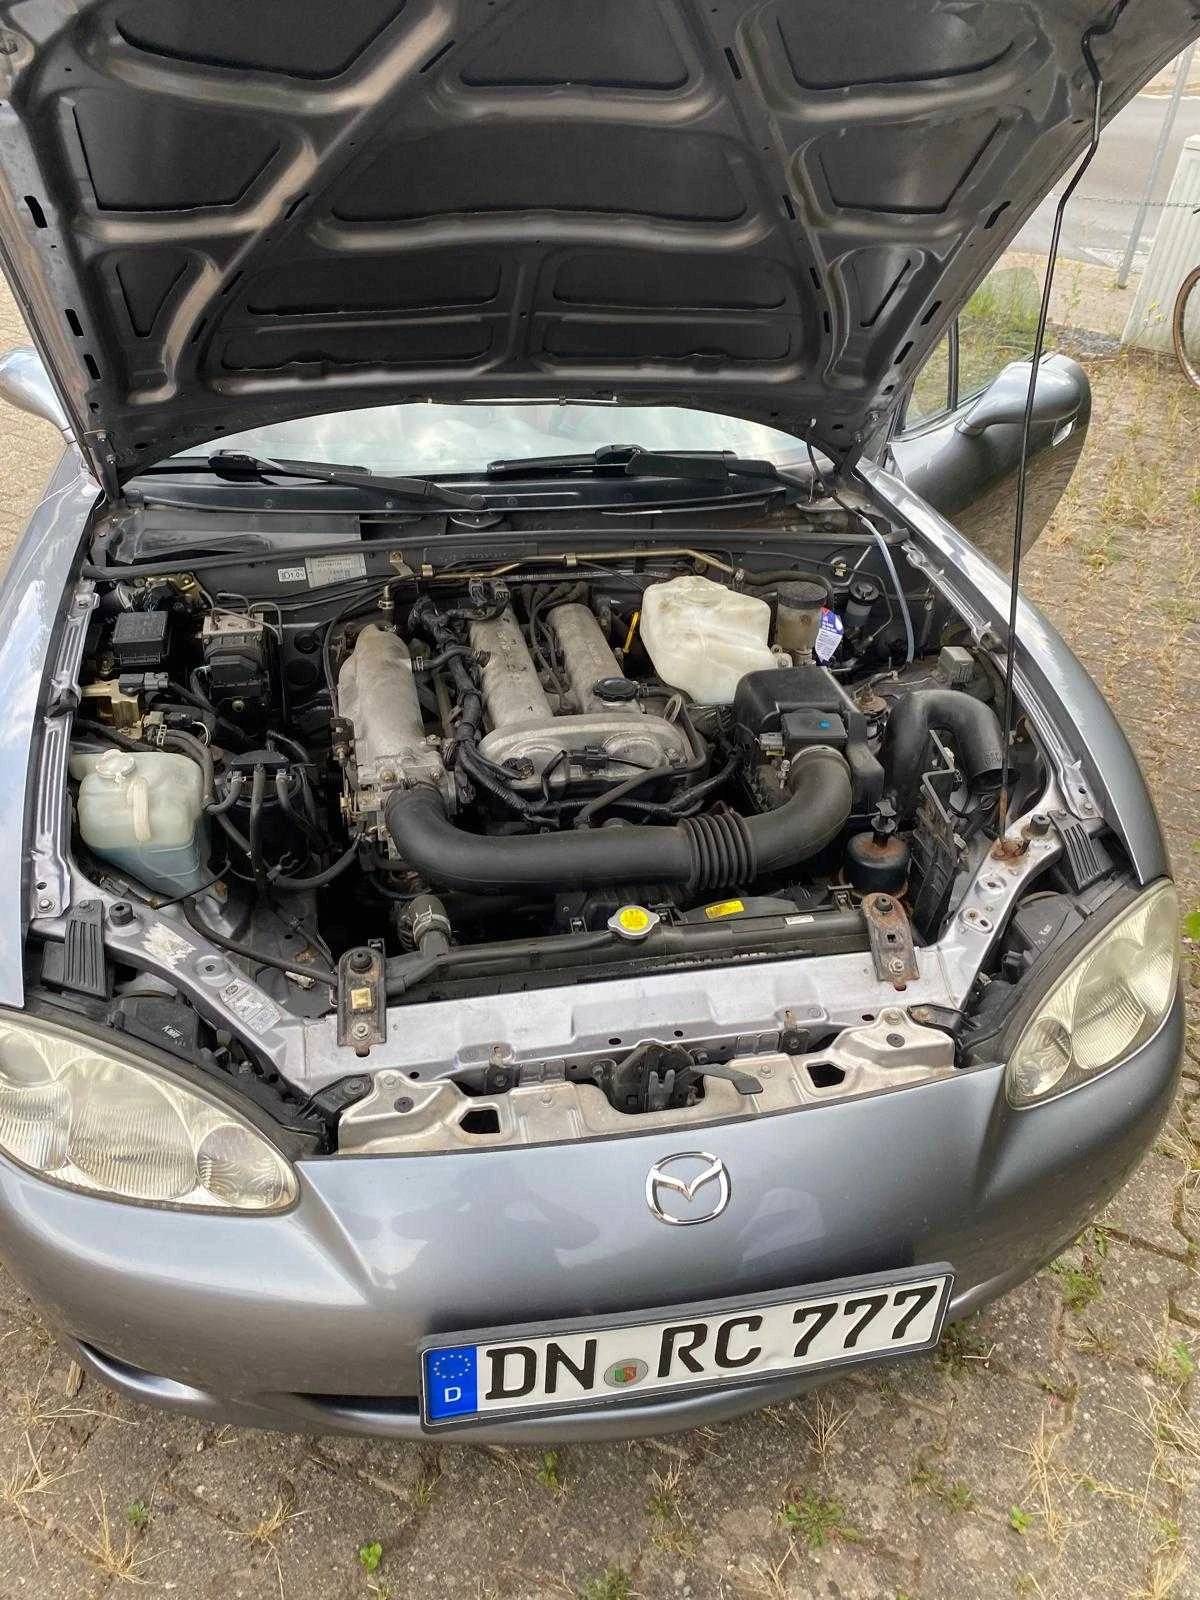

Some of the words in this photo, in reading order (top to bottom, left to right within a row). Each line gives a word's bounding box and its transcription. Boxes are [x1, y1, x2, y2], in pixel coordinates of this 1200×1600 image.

[485, 1338, 597, 1400] DN
[657, 1315, 763, 1378] RC
[792, 1284, 938, 1358] 777
[444, 1386, 462, 1403] D
